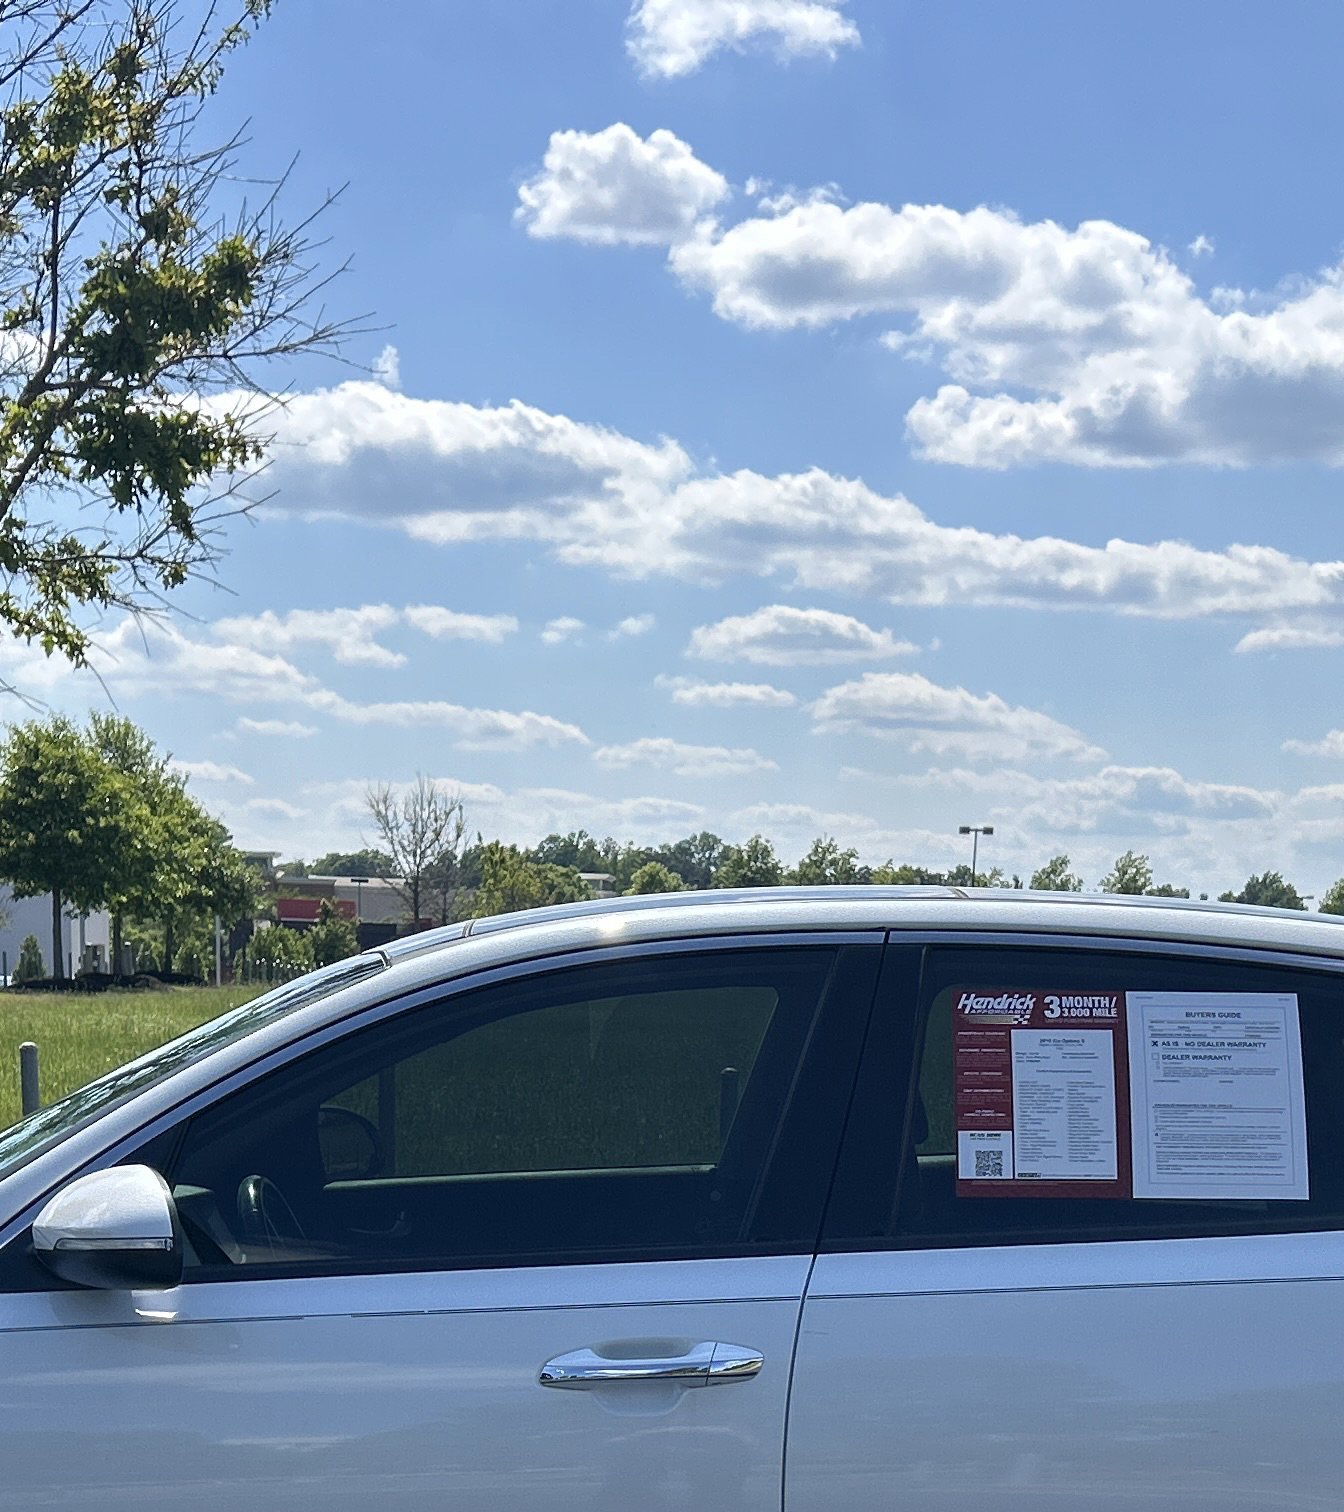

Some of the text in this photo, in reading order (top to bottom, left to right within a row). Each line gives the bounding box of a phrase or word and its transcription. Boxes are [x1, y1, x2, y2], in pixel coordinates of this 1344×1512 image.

[957, 994, 1036, 1014] Hendrick
[1044, 995, 1117, 1018] 3 MONTH/
[1092, 1008, 1118, 1017] MILE
[1226, 1041, 1267, 1049] WARRANTY
